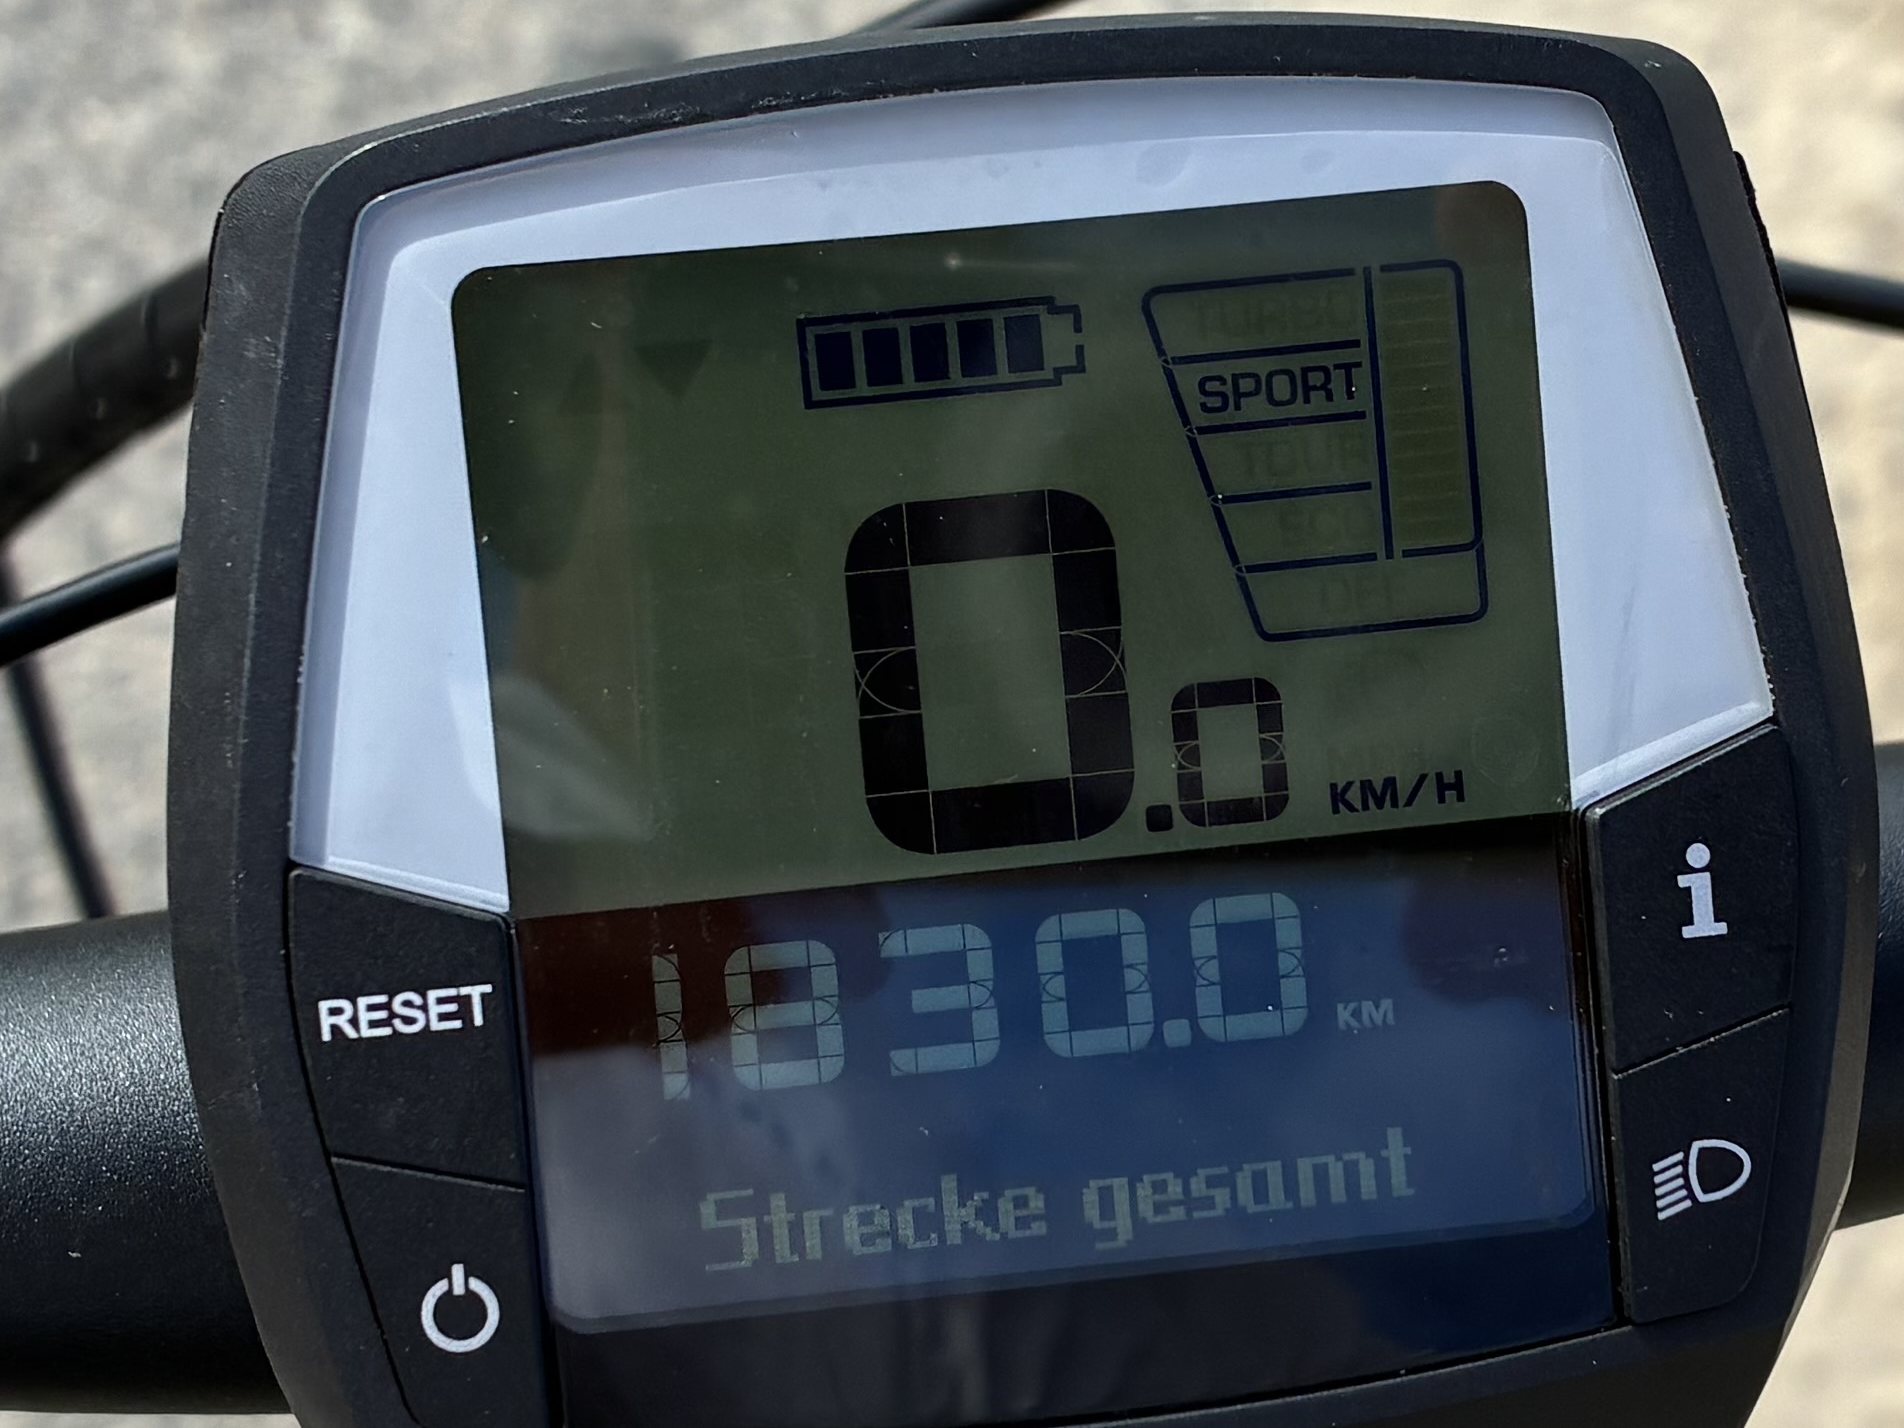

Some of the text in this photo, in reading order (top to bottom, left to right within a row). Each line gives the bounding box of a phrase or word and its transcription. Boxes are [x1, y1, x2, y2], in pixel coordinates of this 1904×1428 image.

[1198, 361, 1363, 414] SPORT
[845, 489, 1467, 855] 0.0 KM/H
[318, 984, 493, 1042] RESET
[652, 892, 1395, 1101] 1830.0 KM
[699, 1127, 1414, 1273] Strecke gesamt
